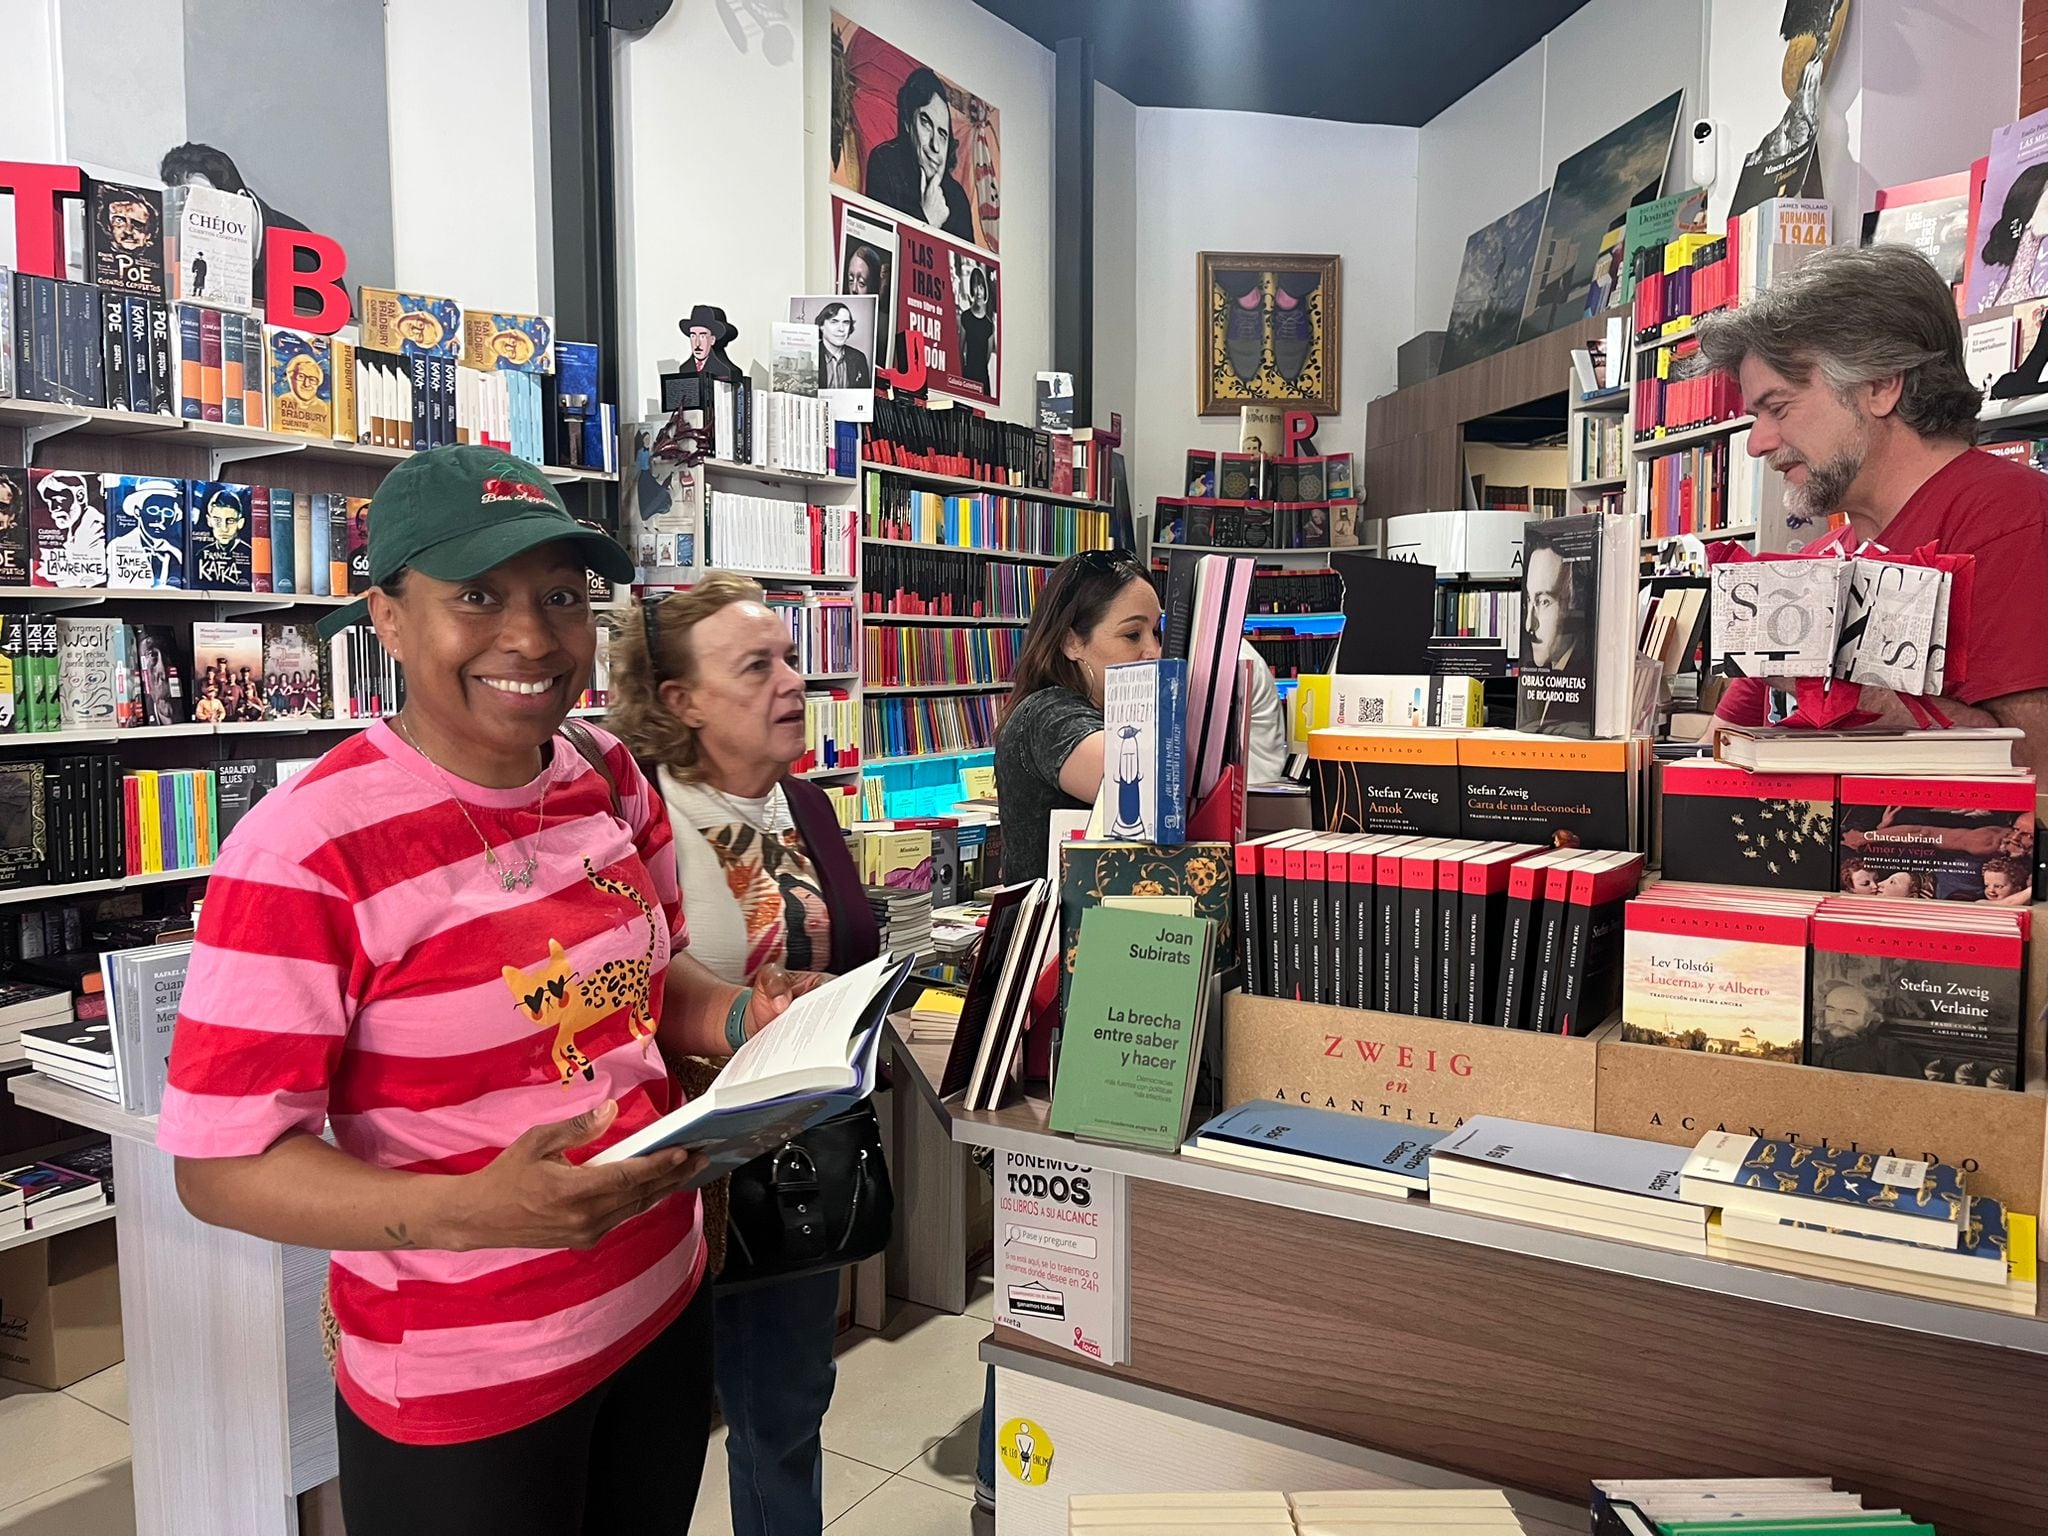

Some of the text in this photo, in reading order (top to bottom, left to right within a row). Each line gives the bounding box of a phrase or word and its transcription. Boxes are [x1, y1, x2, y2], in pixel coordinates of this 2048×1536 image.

[189, 213, 247, 236] CHÉJOV
[1779, 211, 1826, 225] NORMANDÍA
[1779, 224, 1826, 246] 1944
[115, 254, 152, 284] POE
[265, 226, 351, 335] B
[107, 302, 122, 333] POE
[387, 301, 396, 319] RAY
[936, 307, 943, 315] de
[152, 310, 167, 342] POE
[378, 300, 389, 347] BRADBURY
[481, 321, 490, 338] RAY
[909, 311, 941, 342] PILAR
[474, 321, 483, 365] BRADBURY
[885, 329, 927, 392] J
[281, 400, 297, 410] RAY
[281, 408, 327, 423] BRADBURY
[116, 554, 149, 569] JAMES
[203, 549, 232, 560] FRANZ
[47, 560, 103, 577] LAWRENCE
[117, 566, 152, 584] JOYCE
[199, 558, 243, 584] KAFKA
[64, 624, 111, 652] Woolf
[1521, 674, 1587, 690] OBRAS COMPLETAS
[1107, 686, 1118, 702] CON
[1527, 689, 1580, 703] DE RICARDO REIS
[1107, 702, 1153, 723] EN LA CABEZA?
[1337, 745, 1424, 754] ACANTILADO
[1491, 750, 1588, 759] ACANTILADO
[219, 765, 257, 775] SARAJEVO
[220, 774, 243, 784] BLUES
[1367, 786, 1440, 804] Stefan Zweig
[1467, 784, 1529, 800] Stefan Zweig
[1879, 789, 1992, 799] ACANTILADO
[1369, 802, 1403, 814] Amok
[1467, 799, 1592, 815] Carta de una desconocida
[1863, 830, 1943, 845] Chateaubriand
[1864, 843, 1937, 858] Amor y vejez
[1863, 856, 1901, 864] POSTFACIO
[1660, 917, 1766, 932] ACANTILADO
[1155, 927, 1194, 946] Joan
[1855, 936, 1977, 952] ACANTILADO
[1129, 943, 1191, 965] Subirats
[1544, 941, 1552, 962] STEFAN
[1651, 955, 1714, 973] Lev Tolstói
[1707, 982, 1715, 993] y
[1899, 978, 1990, 1002] Stefan Zweig
[156, 994, 167, 1004] se
[1649, 992, 1688, 1001] TRADUCCIÓN
[1930, 999, 1989, 1018] Verlaine
[1108, 1006, 1181, 1031] La brecha
[1930, 1021, 1977, 1031] TRADUCCIÓN
[156, 1025, 170, 1033] un
[1093, 1027, 1179, 1050] entre saber
[1121, 1050, 1177, 1071] y hacer
[1324, 1035, 1473, 1077] ZWEIG
[1385, 1077, 1408, 1094] en
[1382, 1140, 1417, 1165] Calasso
[1007, 1173, 1092, 1208] TODOS
[1000, 1197, 1012, 1211] LOS
[1012, 1199, 1039, 1216] LIBROS
[1046, 1207, 1056, 1218] SU
[1056, 1208, 1098, 1227] ALCANCE
[1022, 1230, 1078, 1249] Pase y pregunte
[1041, 1260, 1099, 1280] se lo traemos o
[1028, 1267, 1099, 1293] donde desee en 24h
[1016, 1301, 1056, 1312] ganamos todos
[1082, 1342, 1100, 1356] local
